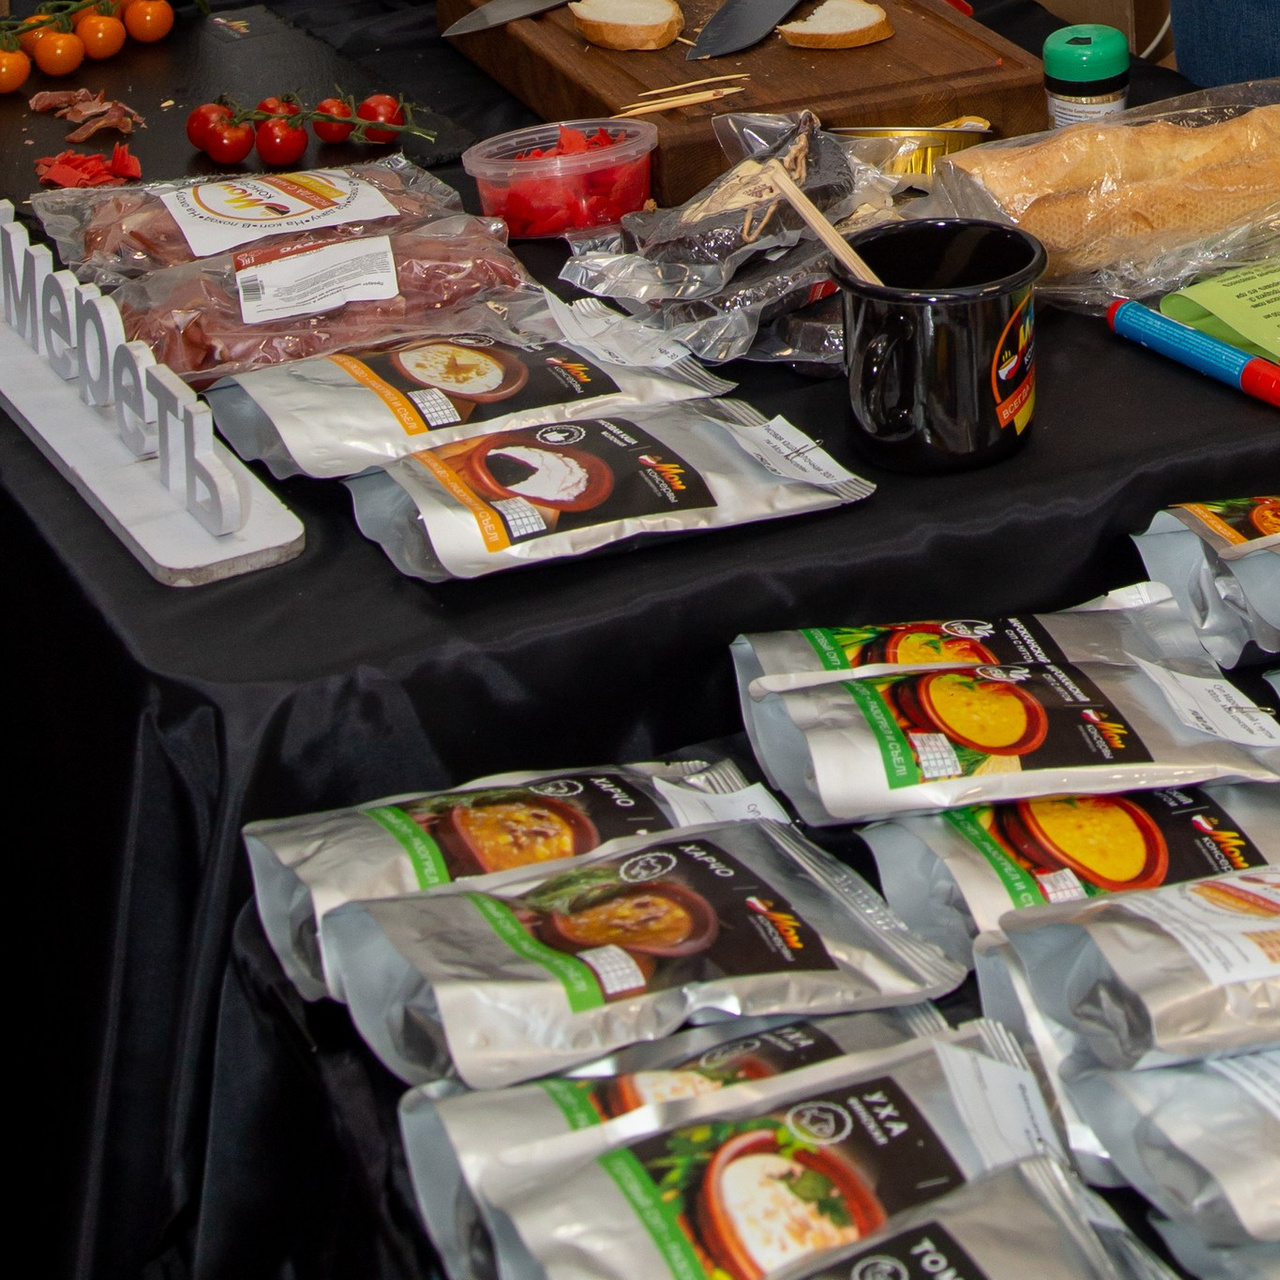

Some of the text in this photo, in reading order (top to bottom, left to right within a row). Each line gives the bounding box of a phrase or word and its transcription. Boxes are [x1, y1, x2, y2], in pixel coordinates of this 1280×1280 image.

[1002, 384, 1031, 421] ВСЕГДА
[645, 467, 680, 504] консервы
[589, 776, 636, 809] ХАРЧО
[678, 843, 735, 879] ХАРЧО
[862, 1090, 909, 1138] УХА
